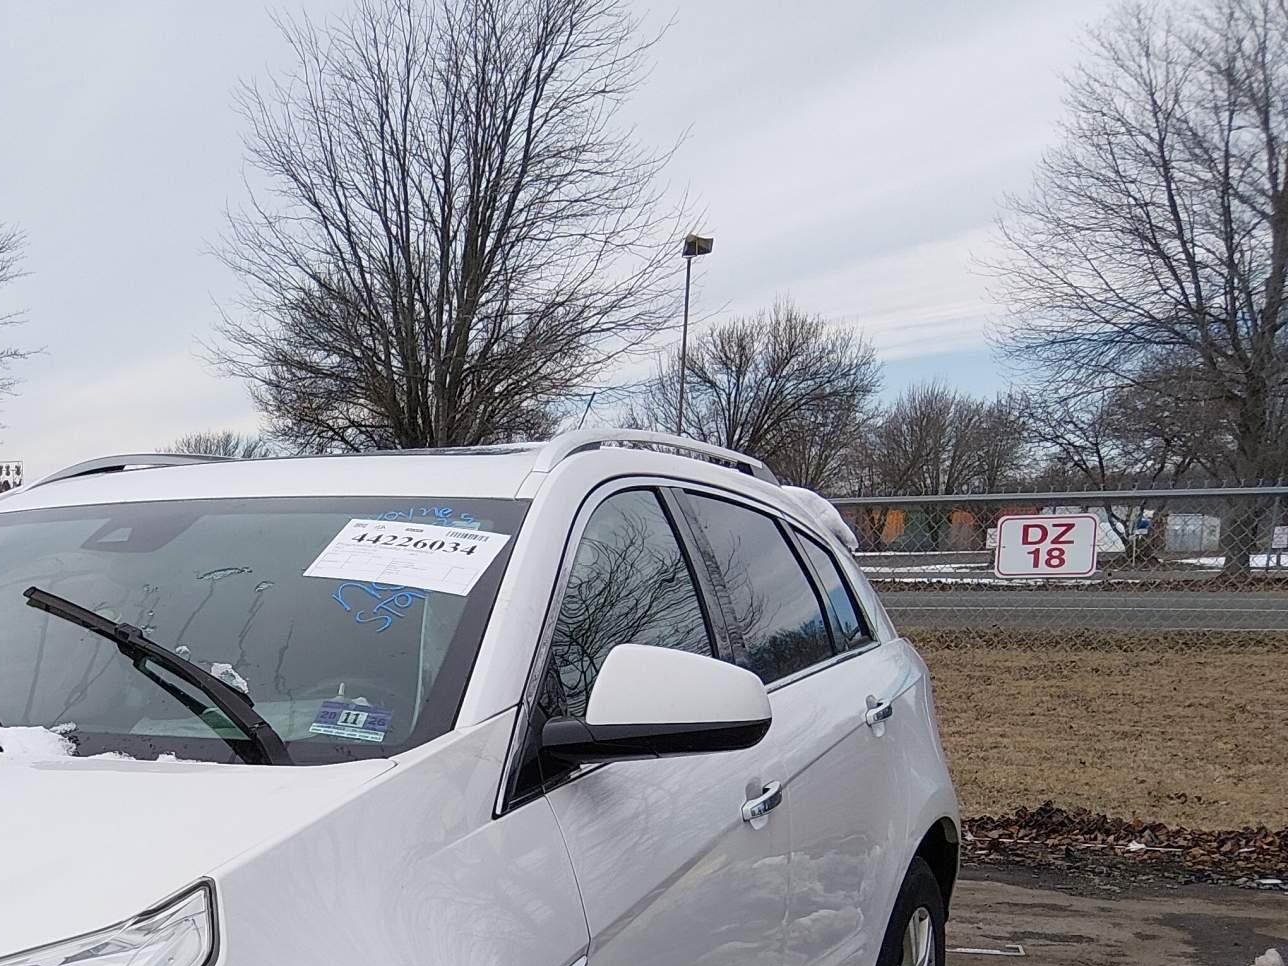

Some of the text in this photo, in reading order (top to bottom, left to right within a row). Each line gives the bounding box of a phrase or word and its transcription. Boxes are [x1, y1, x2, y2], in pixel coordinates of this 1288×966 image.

[351, 532, 478, 556] 44226034
[1021, 522, 1076, 546] DZ
[1026, 547, 1066, 569] 18
[340, 711, 361, 726] 11
